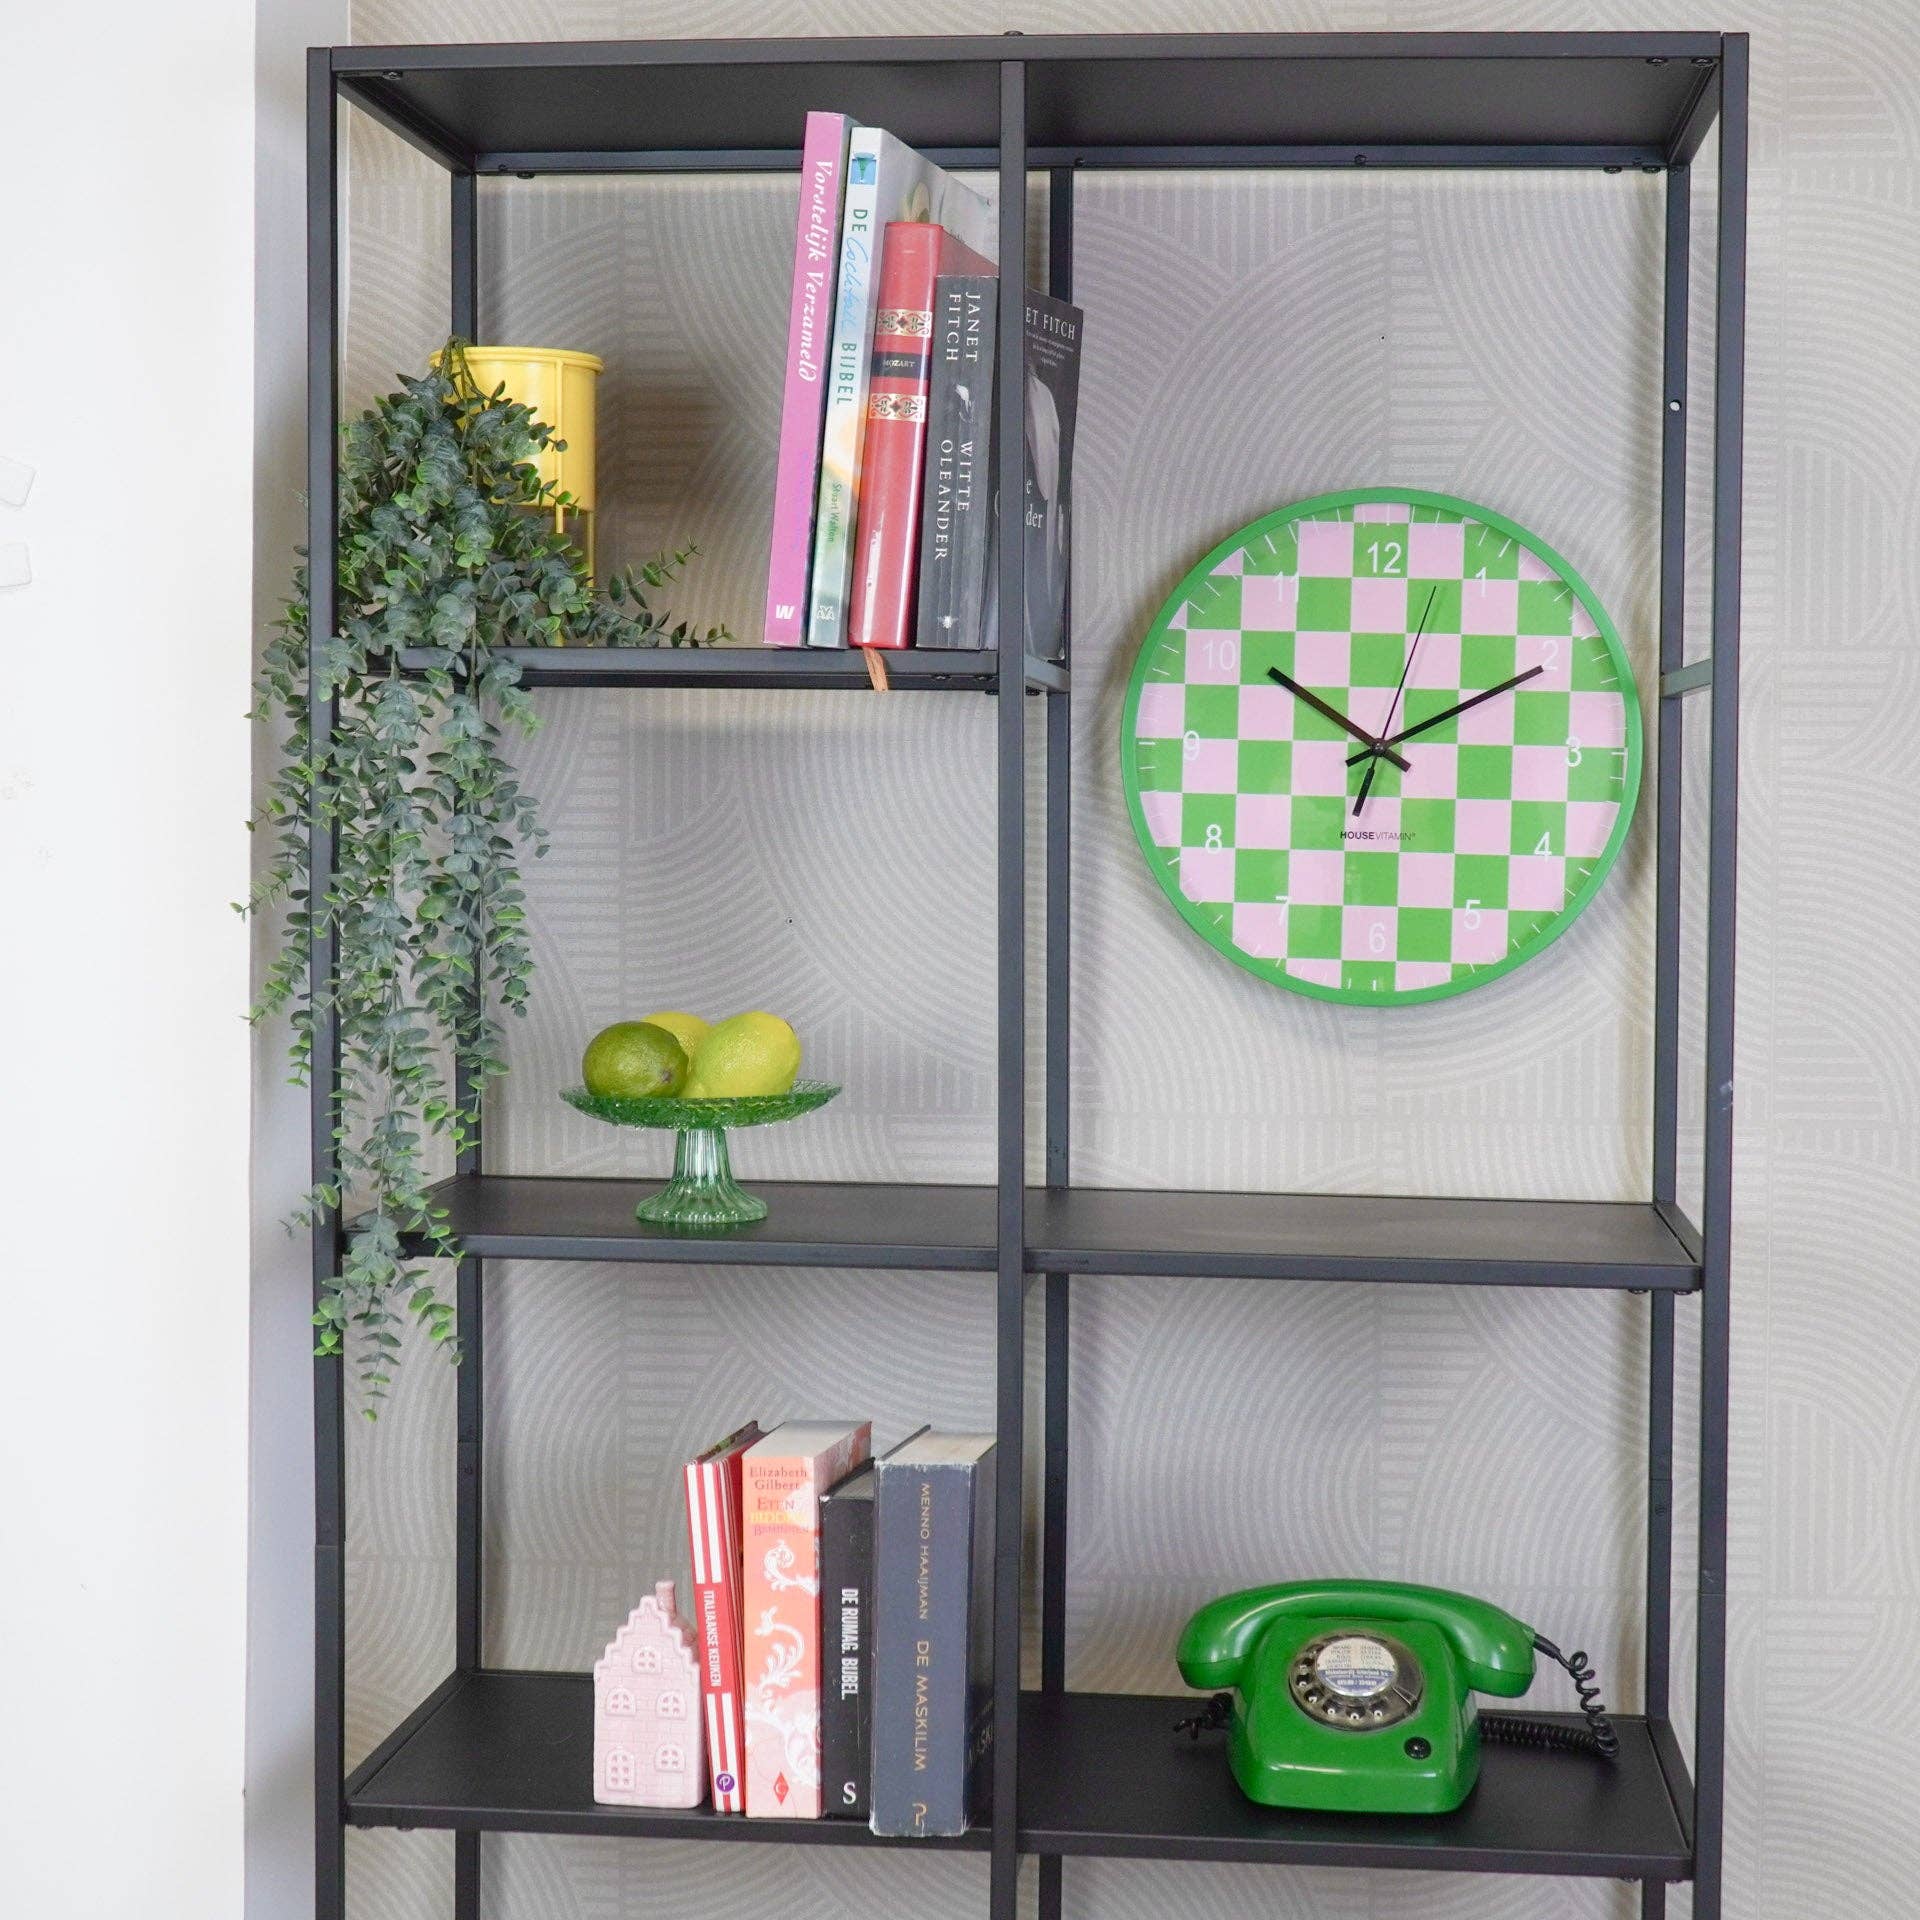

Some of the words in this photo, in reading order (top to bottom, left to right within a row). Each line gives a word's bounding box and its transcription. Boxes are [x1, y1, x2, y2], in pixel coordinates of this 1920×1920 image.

[804, 160, 833, 262] Vorstelijk
[851, 208, 868, 232] DE
[946, 294, 961, 361] FITCH
[966, 292, 981, 361] JANET
[1043, 314, 1076, 341] FITCH
[837, 343, 857, 405] BIJBEL
[957, 440, 973, 512] WITTE
[935, 439, 953, 560] OLEANDER
[1367, 543, 1402, 574] 12
[1273, 572, 1299, 603] 11
[1474, 567, 1488, 597] 1
[1202, 640, 1236, 671] 10
[1540, 640, 1560, 671] 2
[1182, 731, 1200, 760] 9
[1565, 737, 1582, 767] 3
[1205, 824, 1223, 854] 8
[1534, 832, 1552, 862] 4
[1275, 895, 1292, 925] 7
[1463, 900, 1481, 930] 5
[1368, 923, 1385, 952] 6
[750, 1466, 807, 1478] Elizabeth
[754, 1479, 800, 1490] Gilbert
[920, 1483, 930, 1539] MENNO
[842, 1588, 859, 1605] DE
[916, 1640, 929, 1667] DE
[914, 1675, 928, 1771] MASKILIM
[842, 1781, 858, 1804] S
